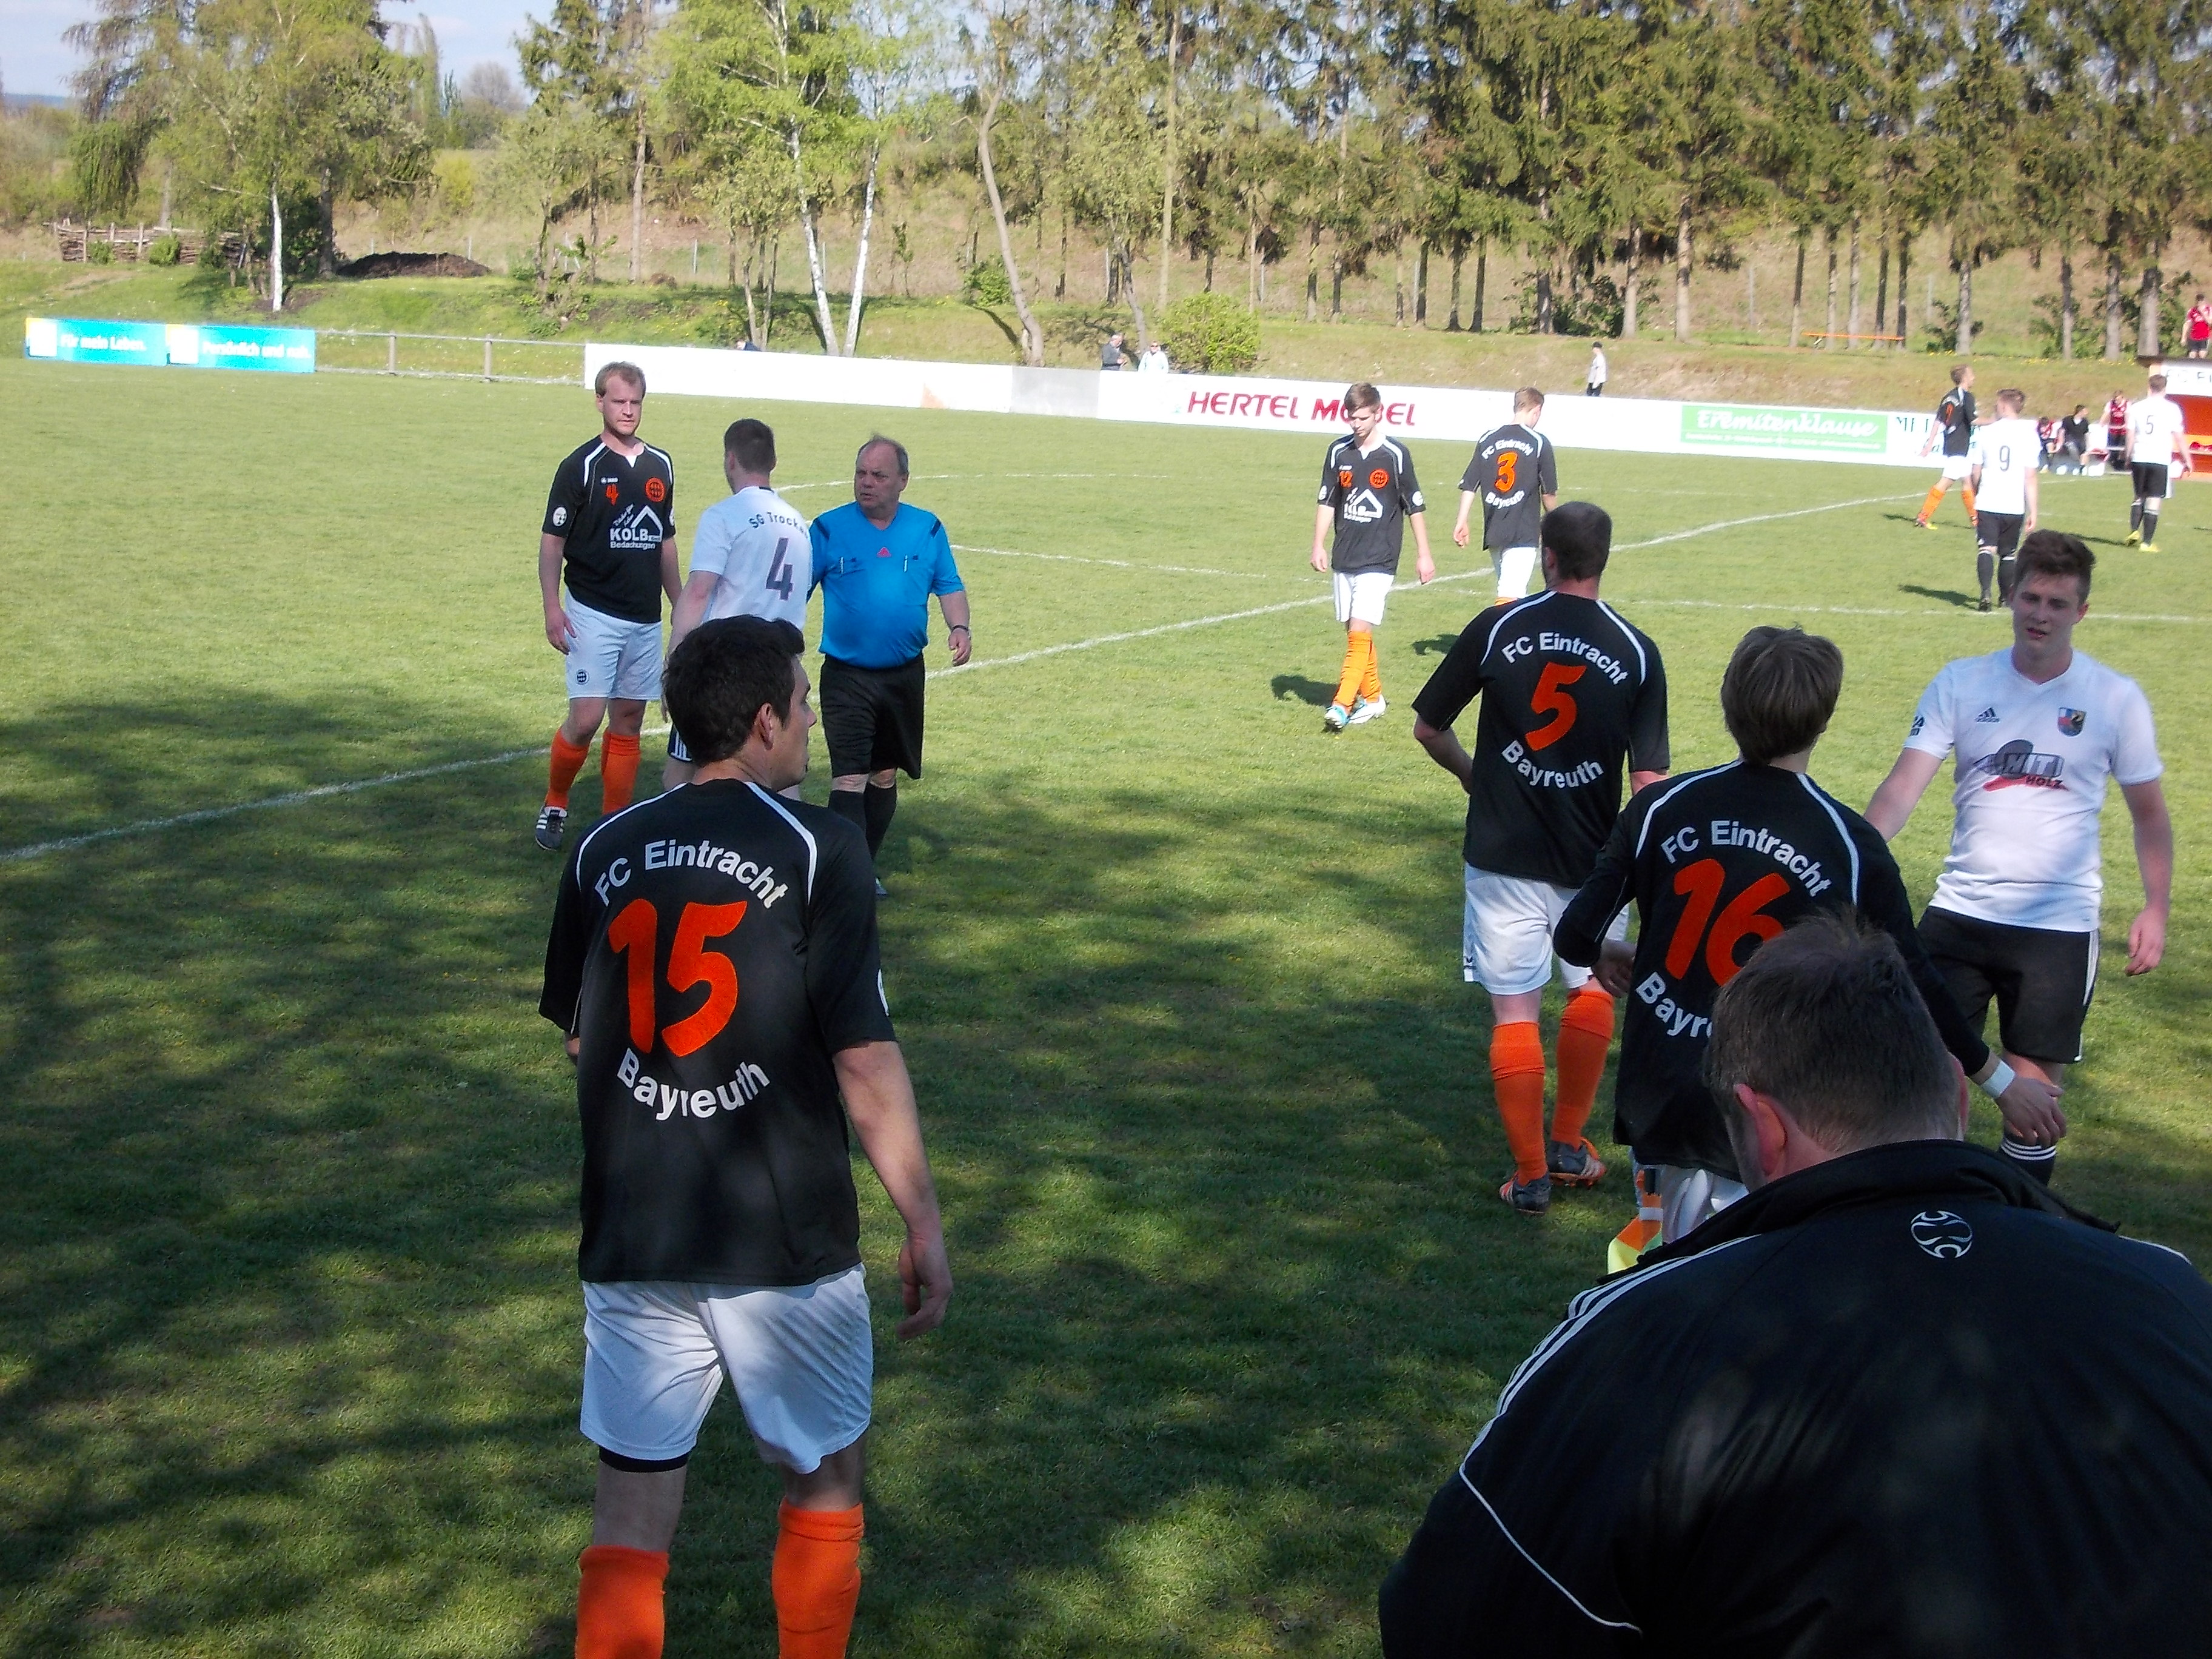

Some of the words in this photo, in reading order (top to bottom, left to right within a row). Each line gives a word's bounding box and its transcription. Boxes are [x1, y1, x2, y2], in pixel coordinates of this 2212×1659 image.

[1187, 391, 1299, 420] HERTEL
[2145, 414, 2154, 435] 5
[1481, 444, 1495, 460] FC
[1495, 451, 1518, 492] 3
[1999, 444, 2011, 472] 9
[605, 483, 620, 506] 4
[1339, 470, 1353, 488] 12
[1484, 490, 1525, 509] Bayreuth
[609, 528, 649, 541] KOLB
[748, 513, 765, 529] SG
[766, 537, 794, 601] 4
[1501, 636, 1534, 664] FC
[1538, 632, 1629, 686] Eintracht
[1524, 662, 1587, 752] 5
[1501, 739, 1605, 788] Bayreuth
[2026, 775, 2063, 789] HOLZ
[594, 857, 632, 907] FC
[644, 839, 788, 910] Eintracht
[1660, 826, 1700, 864] FC
[1711, 820, 1832, 898] Eintracht
[1664, 857, 1791, 988] 16
[608, 897, 748, 1058] 15
[1635, 971, 1713, 1040] Bayr
[616, 1047, 771, 1121] Bayreuth
